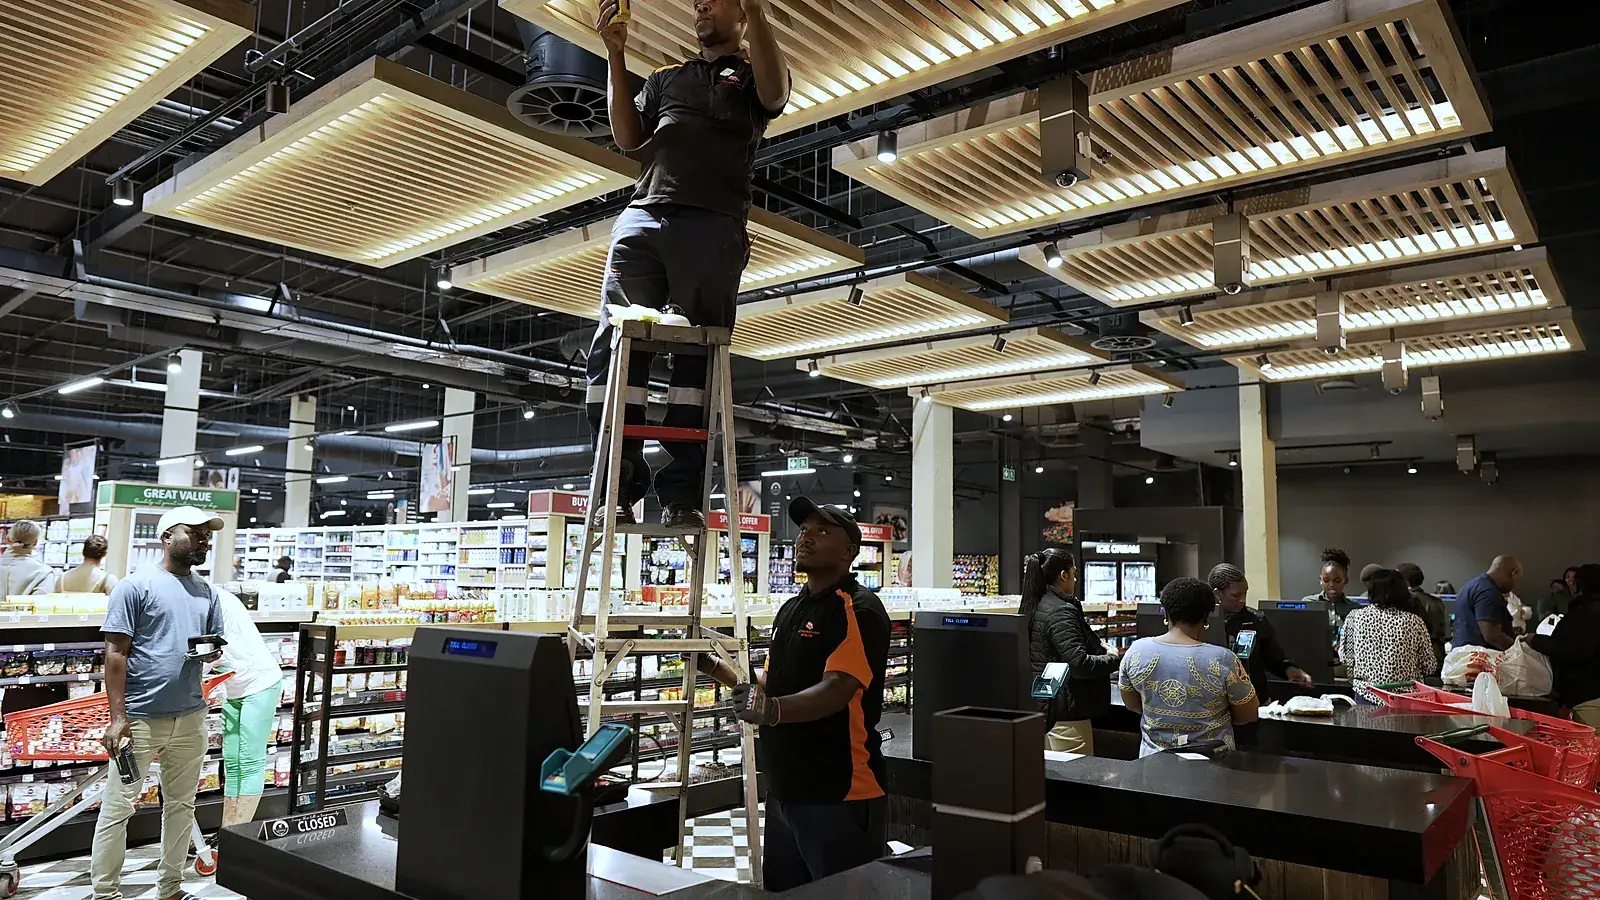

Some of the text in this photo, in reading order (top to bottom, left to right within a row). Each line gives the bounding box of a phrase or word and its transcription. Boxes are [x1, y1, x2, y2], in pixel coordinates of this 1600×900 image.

[143, 488, 212, 502] GREAT VALUE
[571, 496, 588, 507] BUY
[741, 516, 759, 525] OFFER
[1096, 544, 1140, 554] ICE CREAM
[745, 685, 756, 710] uvex
[297, 815, 337, 832] CLOSED
